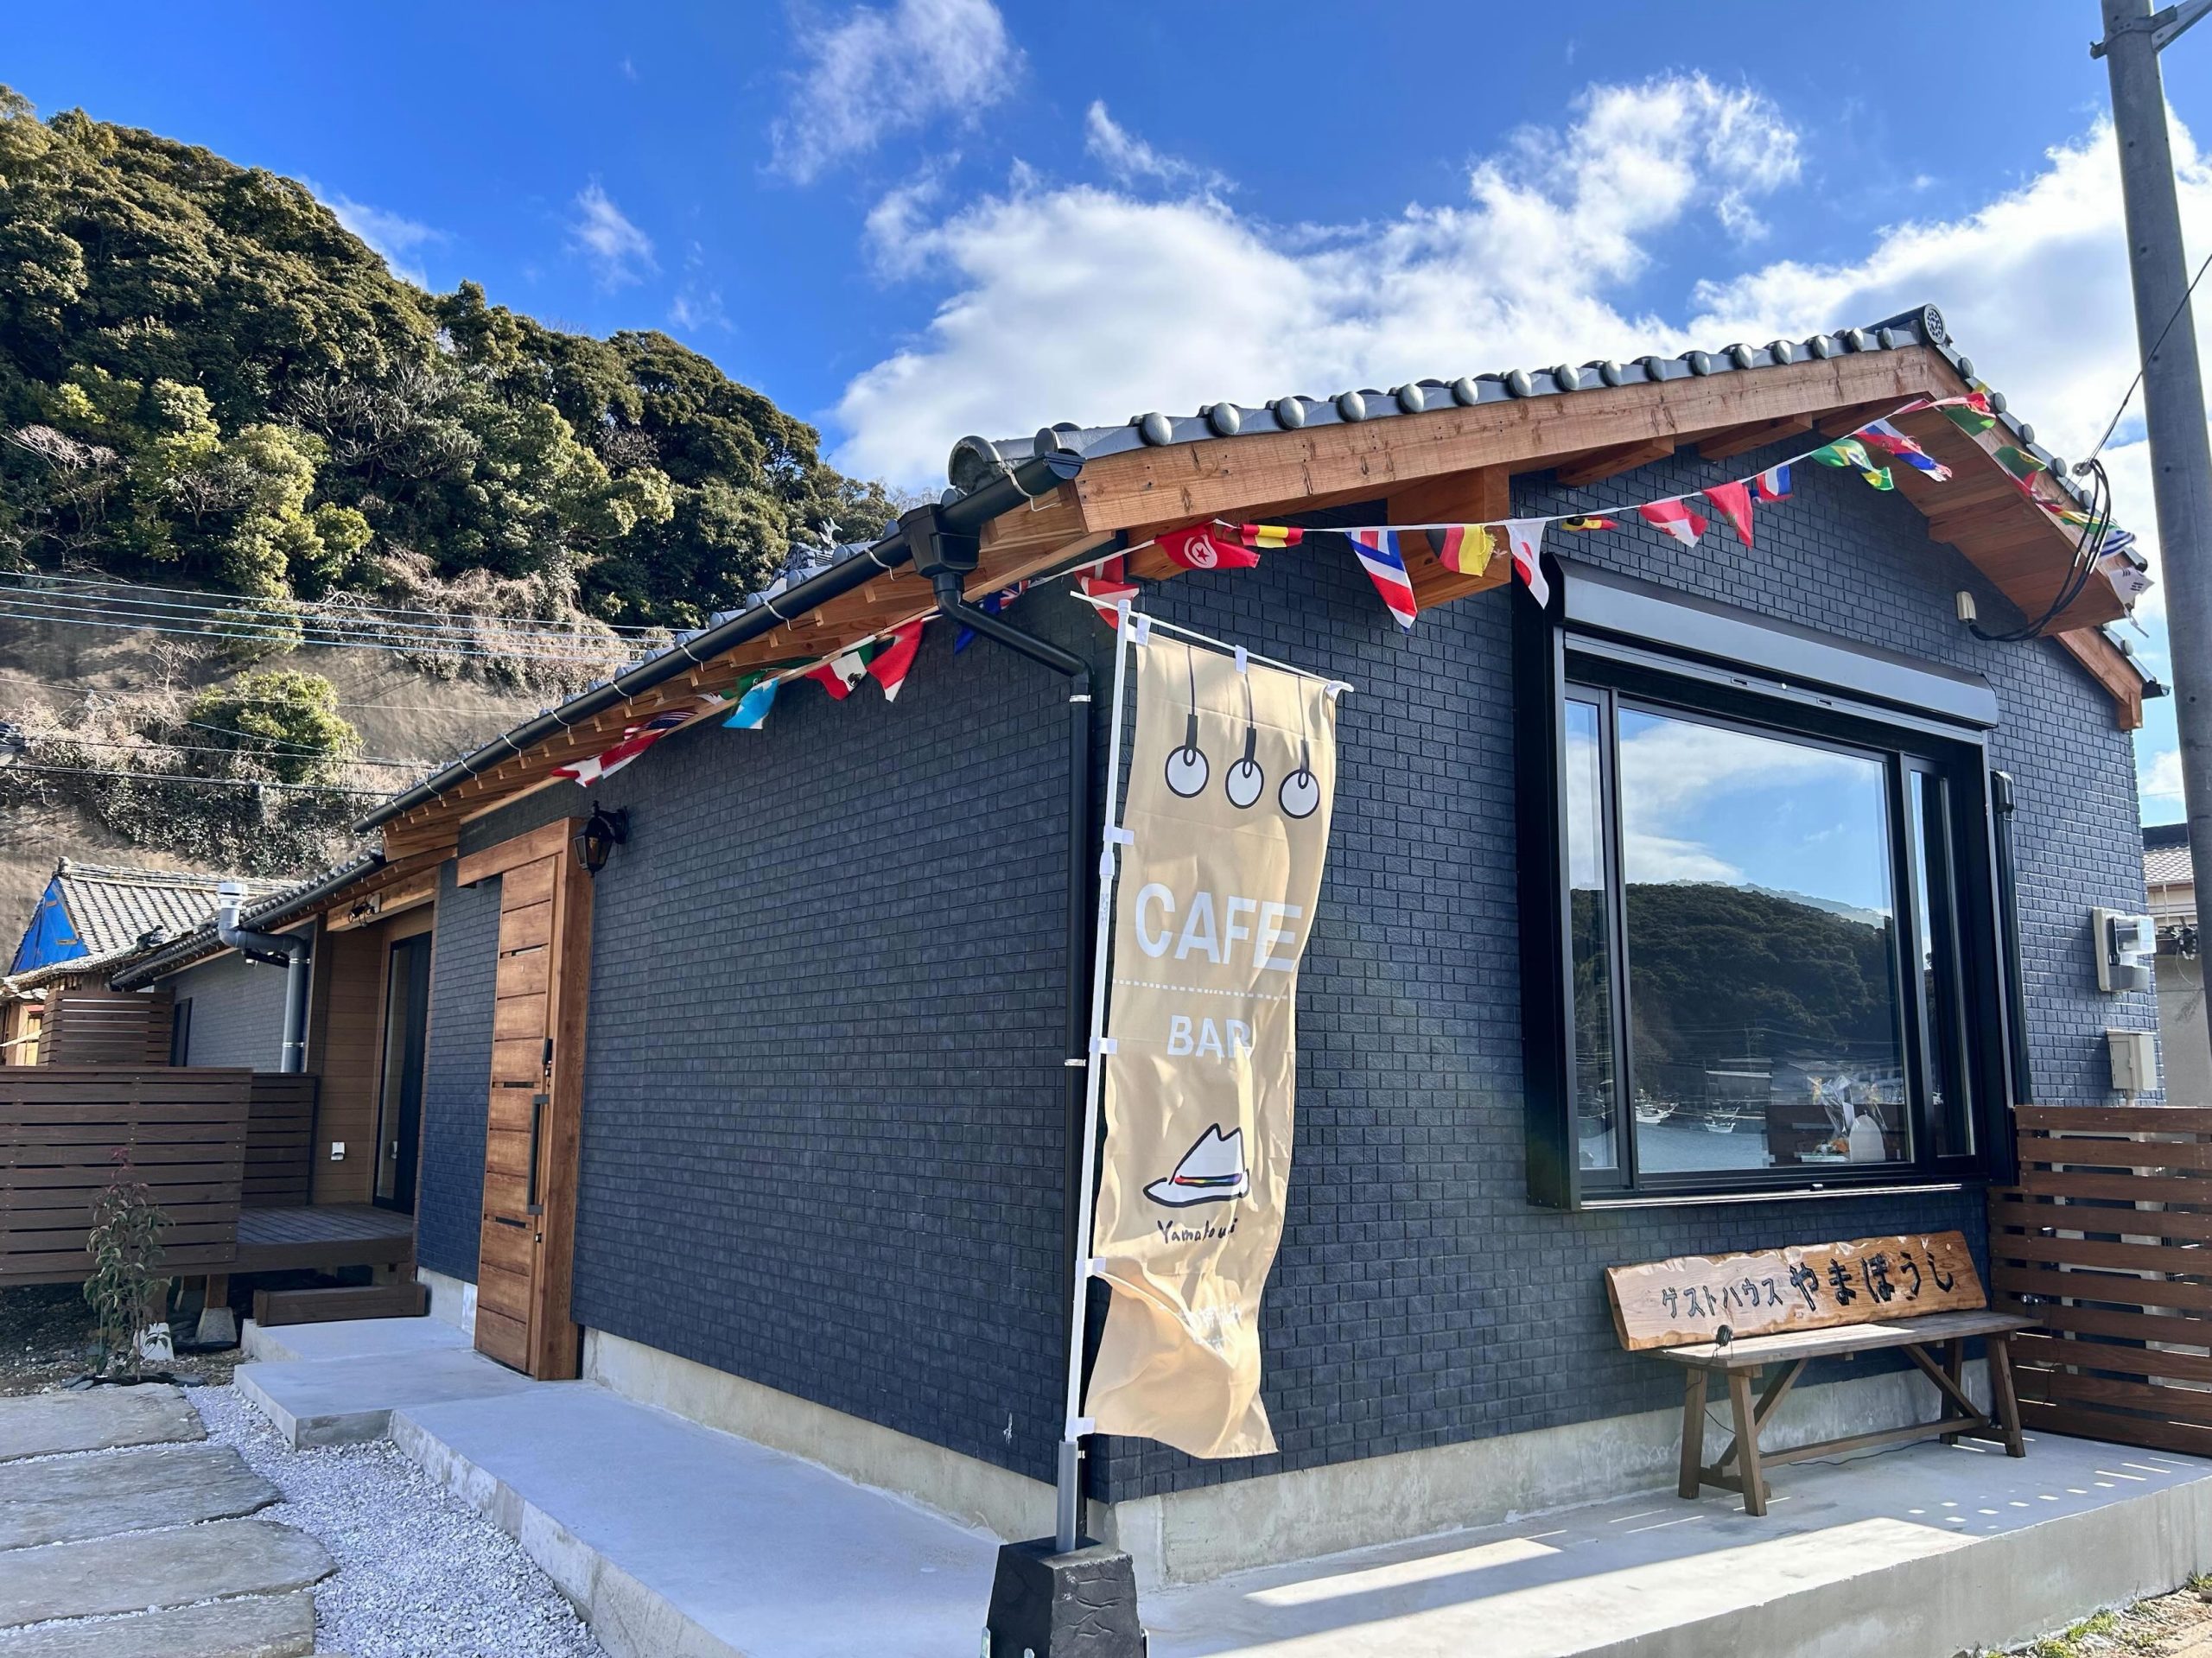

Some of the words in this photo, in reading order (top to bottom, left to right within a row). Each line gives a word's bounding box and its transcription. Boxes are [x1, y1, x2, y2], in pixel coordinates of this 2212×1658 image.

[1135, 883, 1303, 973] CAFE
[1167, 1014, 1253, 1059] BAR
[1662, 1276, 1783, 1318] ゲストハウス
[1789, 1251, 1955, 1312] やまぼうし
